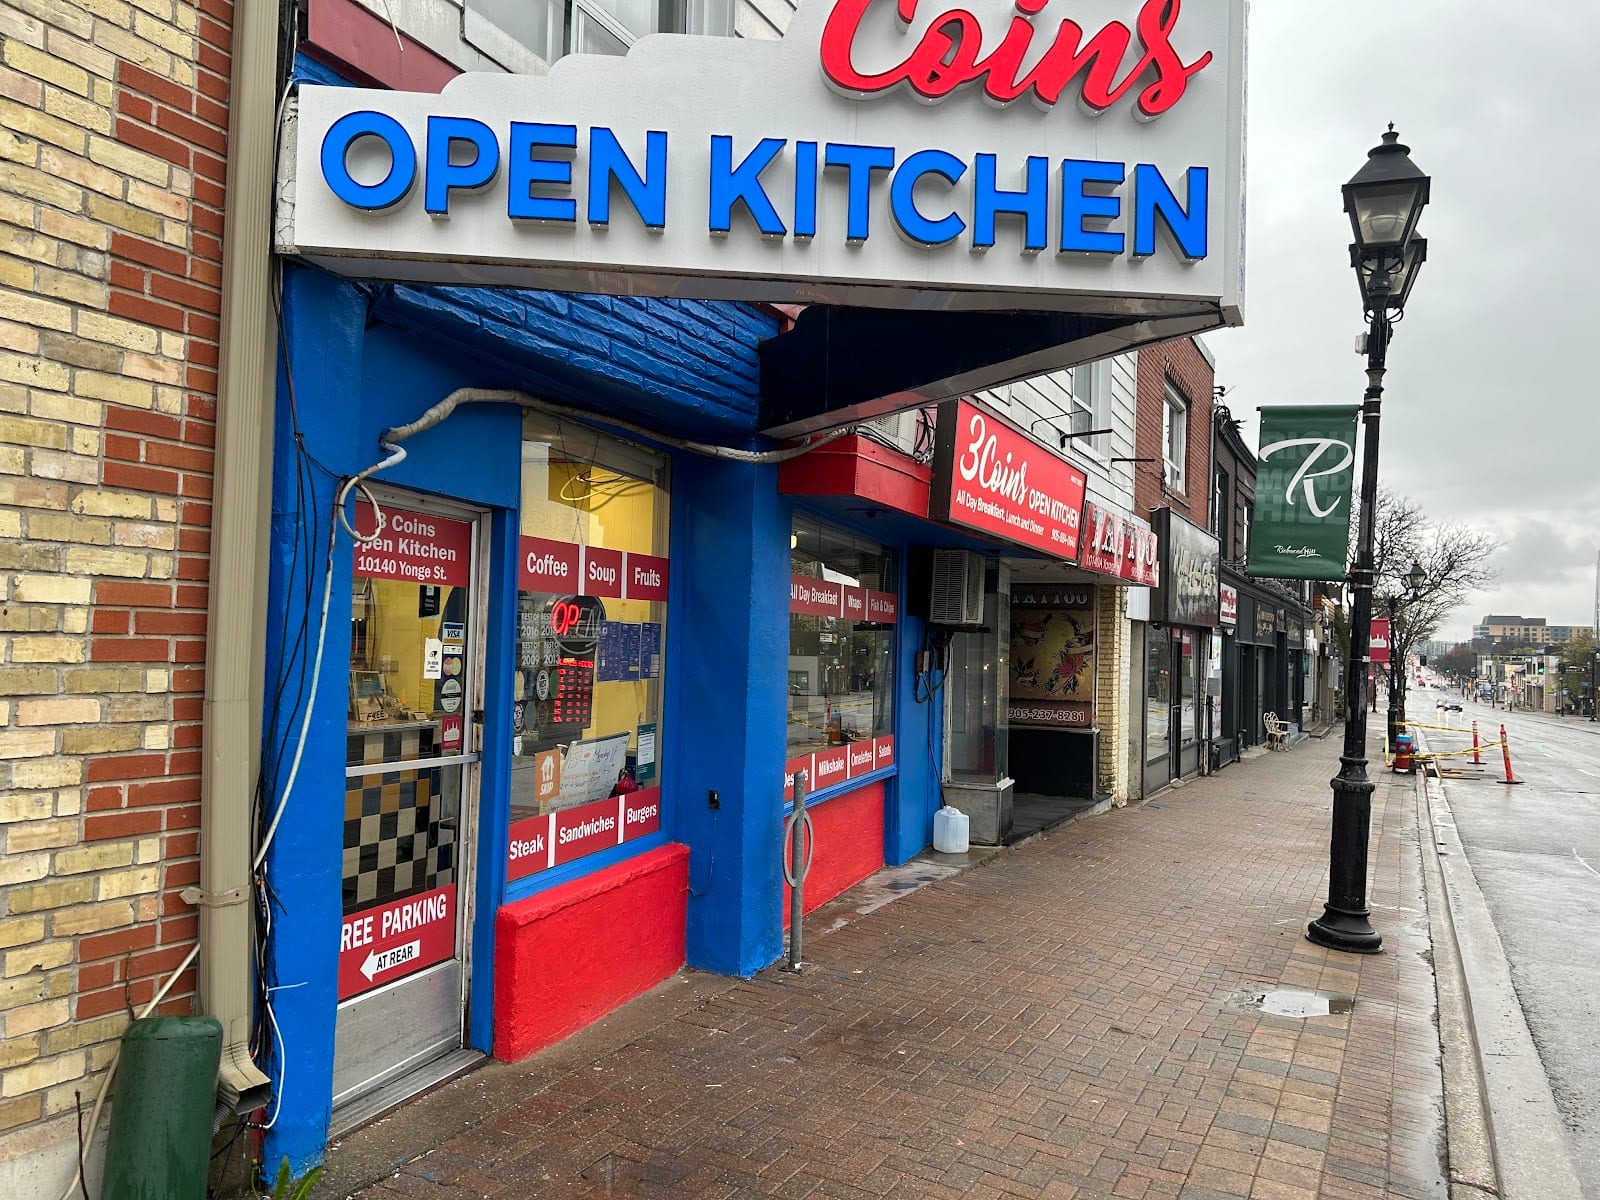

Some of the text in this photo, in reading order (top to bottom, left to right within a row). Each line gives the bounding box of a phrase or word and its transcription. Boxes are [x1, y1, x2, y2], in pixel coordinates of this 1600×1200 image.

[820, 0, 1213, 117] Coins
[320, 110, 1211, 261] OPEN KITCHEN
[959, 414, 1080, 530] 3 Coins OPEN KITCHEN
[956, 489, 965, 505] All
[966, 492, 977, 512] Day
[978, 497, 1006, 523] Breakfast,
[1006, 510, 1020, 526] Lunch
[1021, 515, 1030, 529] and
[1030, 518, 1045, 537] Dinner
[392, 515, 436, 538] Coins
[398, 538, 456, 562] Kitchen
[358, 556, 448, 581] 10140 Yonge St.
[526, 552, 569, 577] Coffee
[588, 560, 616, 586] Soup
[634, 567, 661, 587] Fruits
[799, 585, 810, 604] Day
[811, 587, 838, 606] Breakfast
[847, 594, 862, 611] Wraps
[871, 598, 880, 612] Fish
[884, 600, 895, 615] Chips
[447, 629, 460, 639] VISA
[367, 710, 385, 720] FREE
[1008, 708, 1085, 722] 905-237-8281
[626, 804, 657, 824] Burgers
[559, 816, 615, 844] Sandwiches
[508, 834, 545, 860] Steak
[340, 894, 446, 952] REE PARKING
[377, 945, 413, 971] AT REAR
